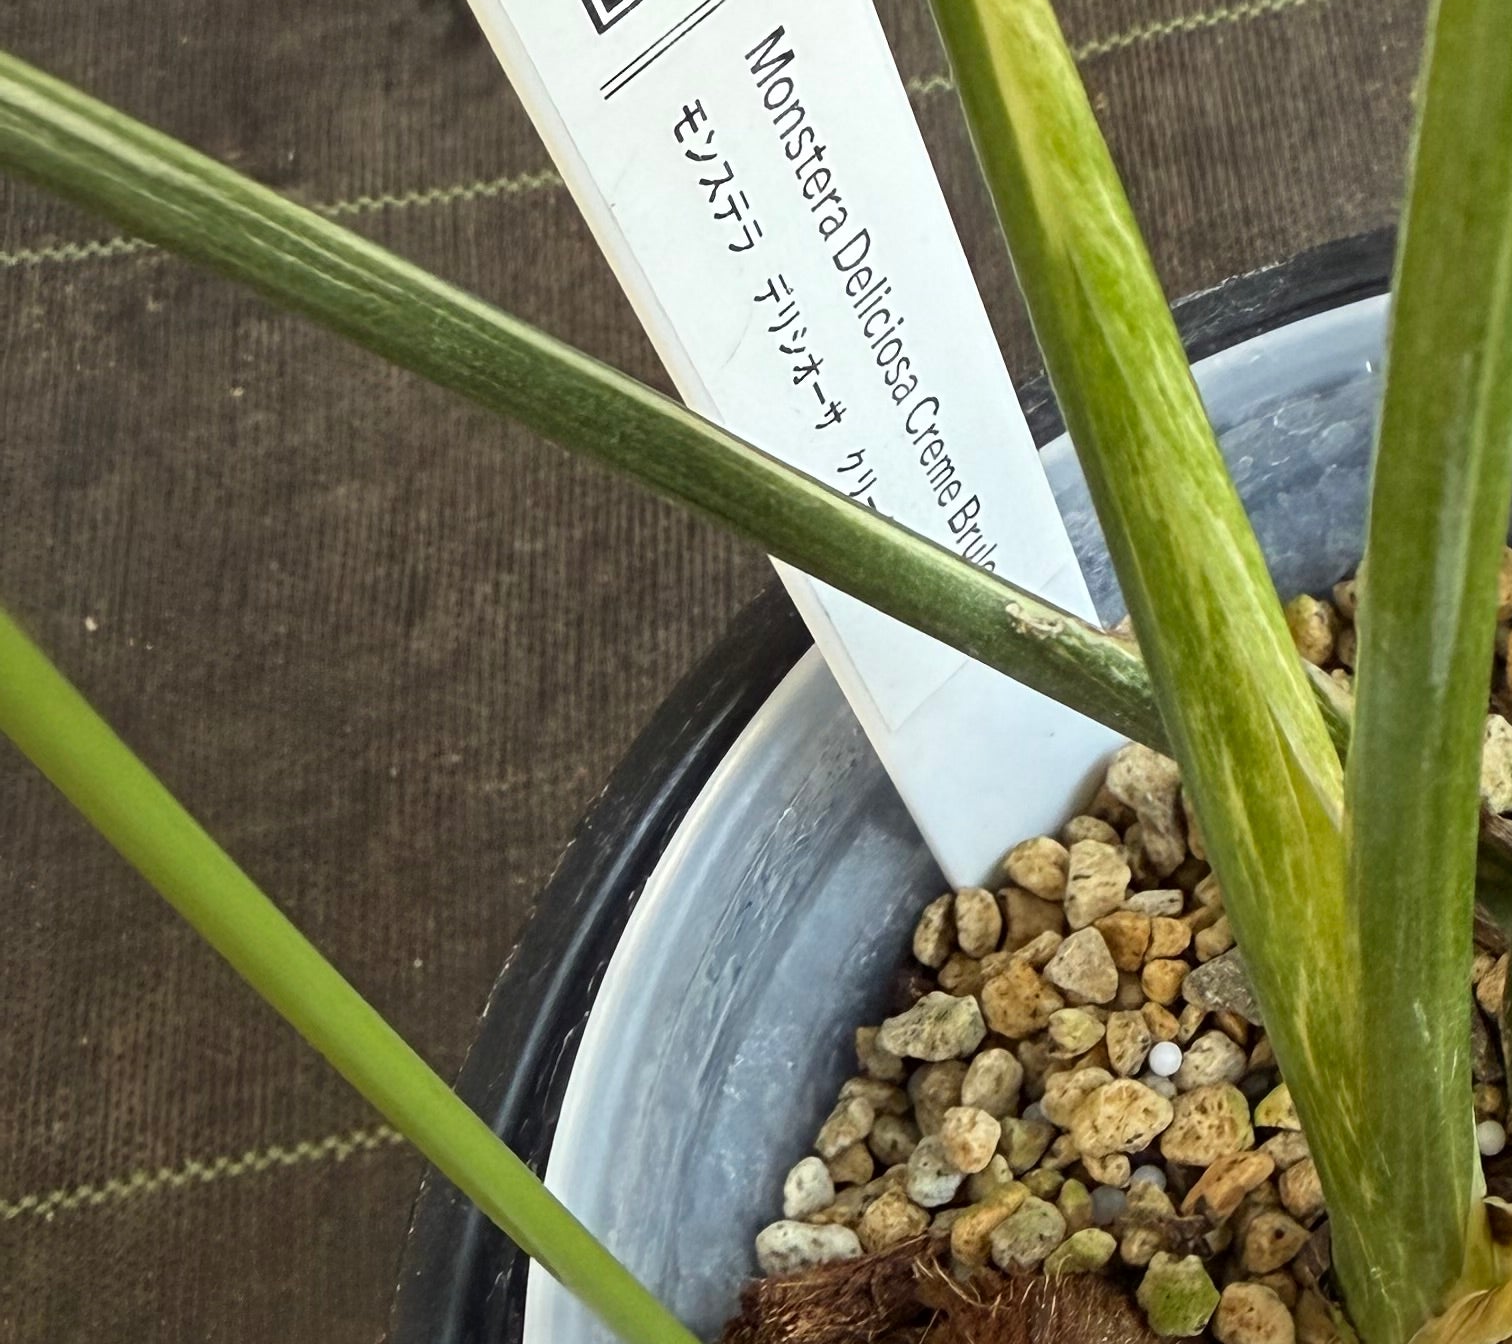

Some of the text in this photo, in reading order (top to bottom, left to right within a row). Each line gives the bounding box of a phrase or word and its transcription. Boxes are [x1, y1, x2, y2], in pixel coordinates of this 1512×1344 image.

[673, 99, 890, 518] モンステラ デリシオーサ クリー
[744, 25, 848, 241] Monstera
[832, 228, 918, 406] Deliciosa
[905, 396, 962, 507] Creme
